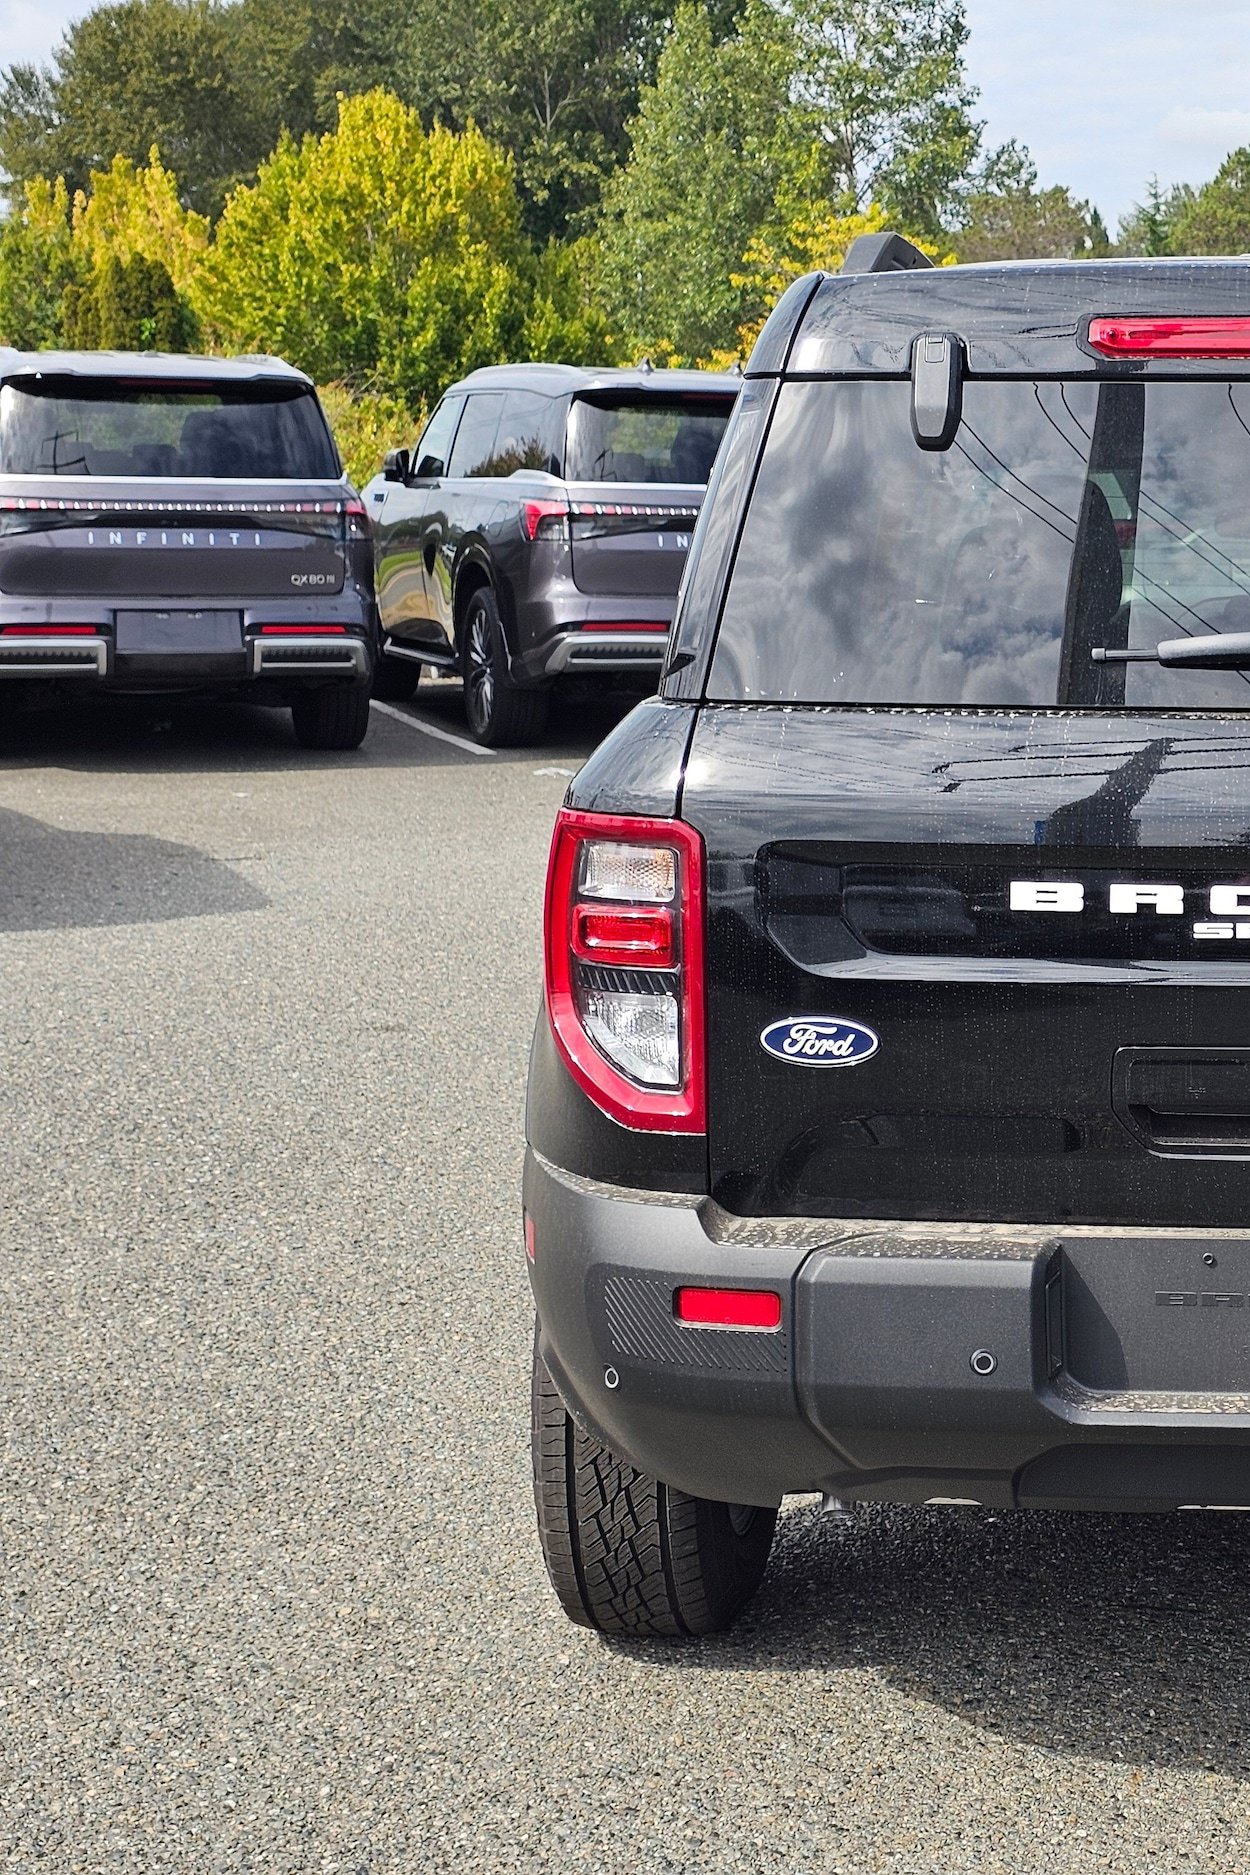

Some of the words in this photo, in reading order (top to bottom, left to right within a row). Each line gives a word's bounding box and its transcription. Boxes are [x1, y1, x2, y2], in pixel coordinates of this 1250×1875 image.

[87, 531, 261, 546] INFINITI
[290, 574, 325, 587] QX80
[782, 1023, 856, 1056] Ford
